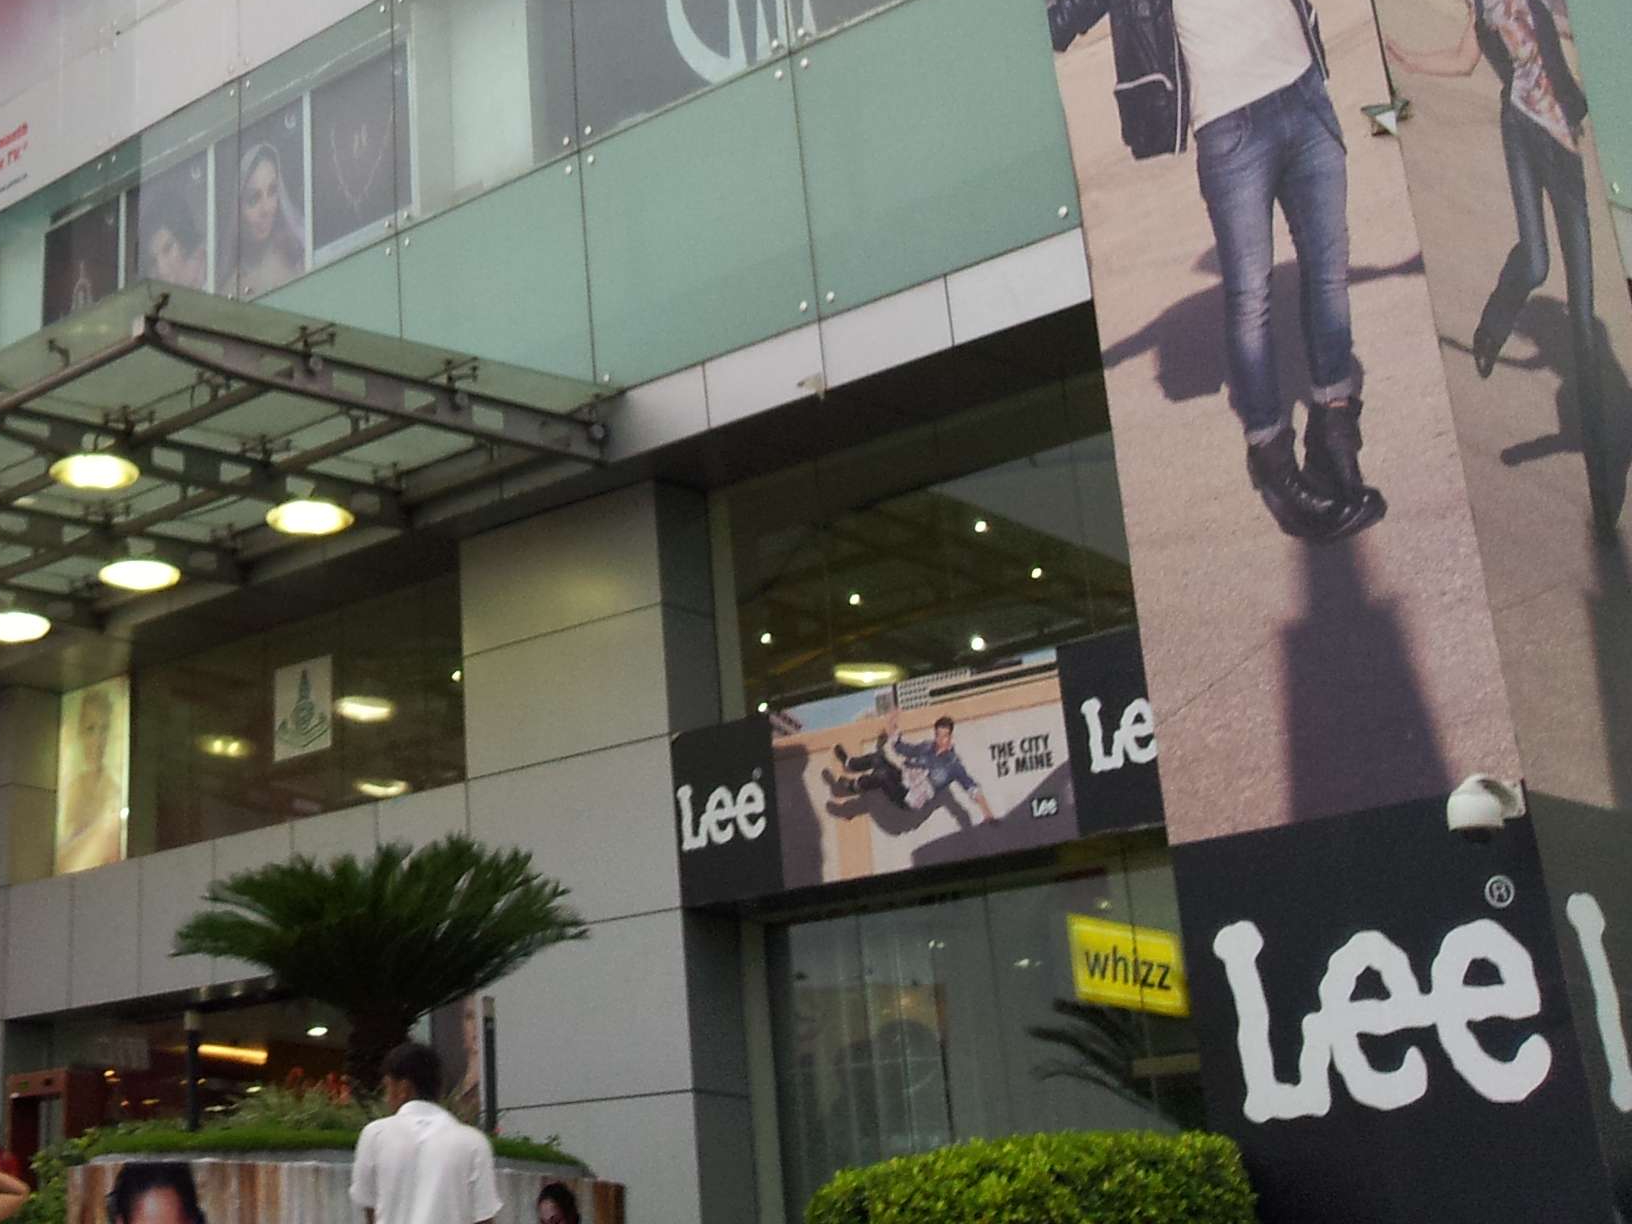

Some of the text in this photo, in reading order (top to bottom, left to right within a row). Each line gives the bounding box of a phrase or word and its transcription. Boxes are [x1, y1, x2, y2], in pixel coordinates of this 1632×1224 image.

[989, 733, 1050, 761] THE CITY
[1080, 697, 1159, 774] Le
[996, 752, 1054, 778] IS MINE
[677, 779, 767, 851] Lee
[1031, 797, 1058, 818] Lee
[1084, 947, 1172, 992] whizz
[1212, 918, 1553, 1124] Lee
